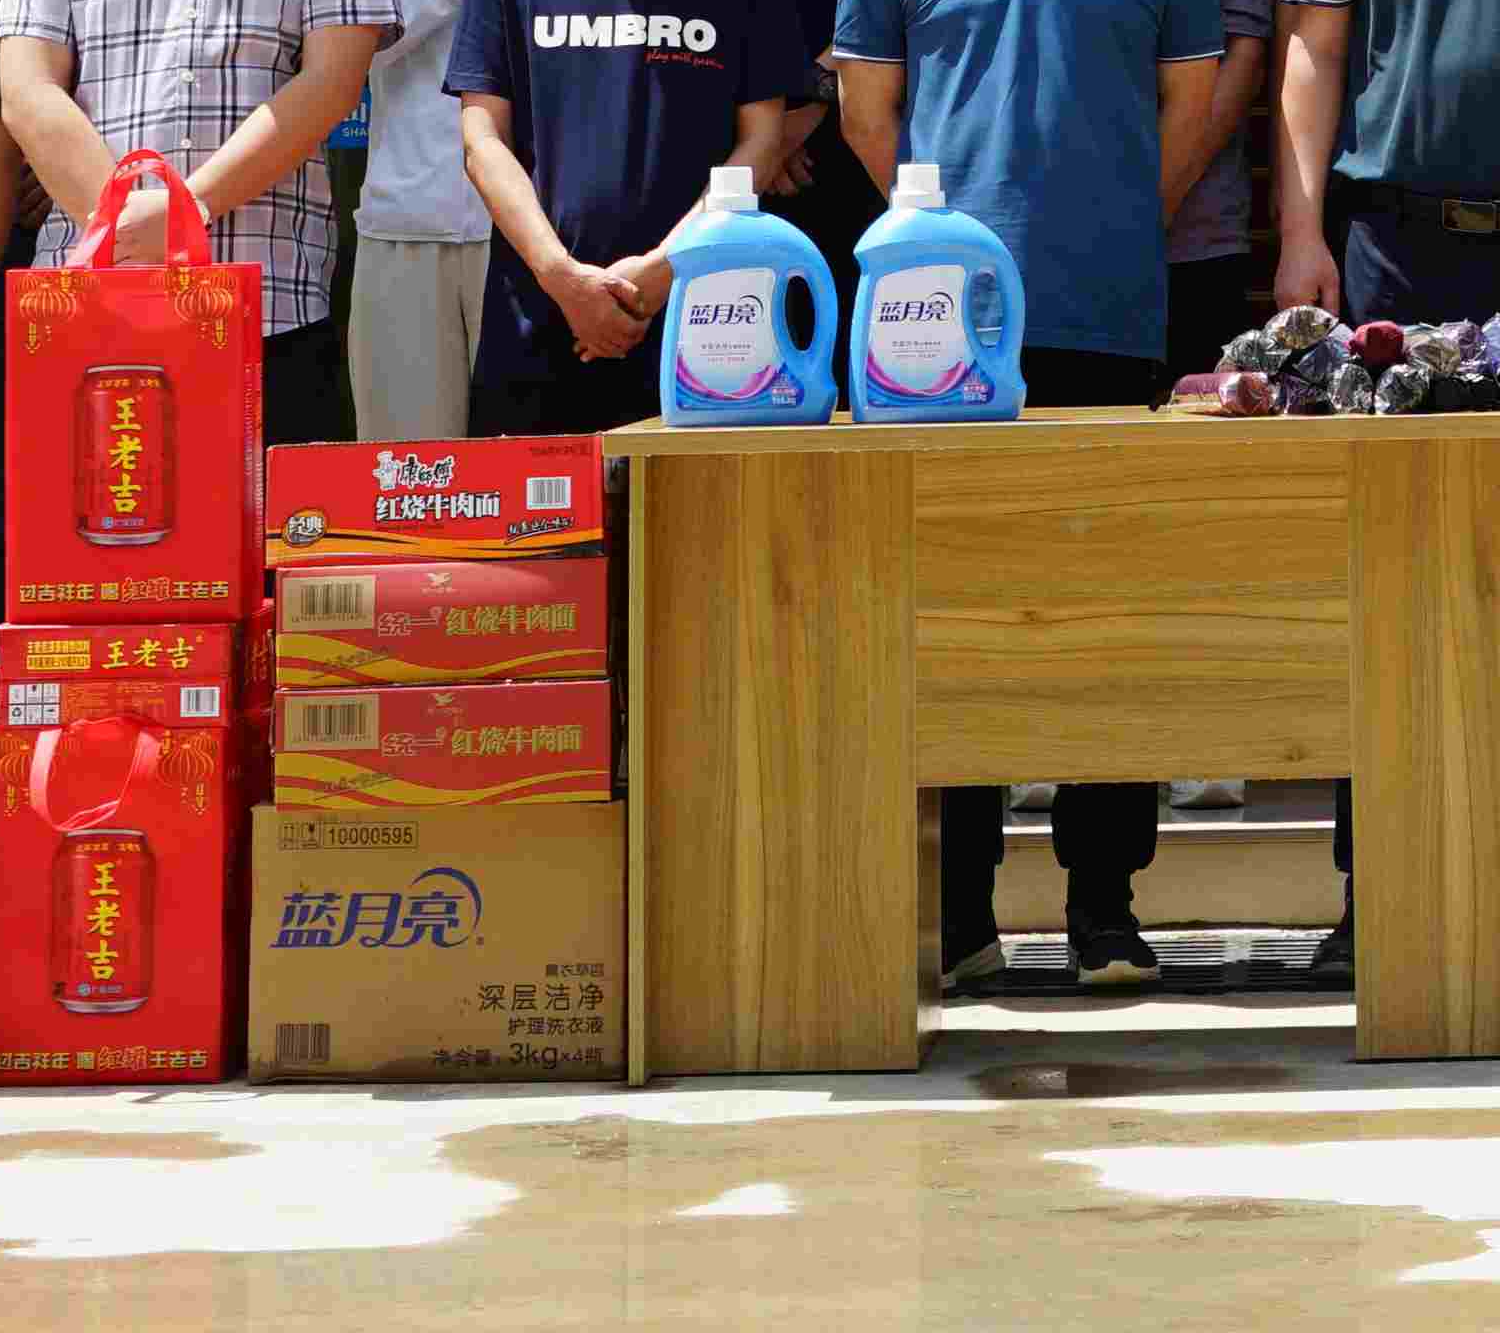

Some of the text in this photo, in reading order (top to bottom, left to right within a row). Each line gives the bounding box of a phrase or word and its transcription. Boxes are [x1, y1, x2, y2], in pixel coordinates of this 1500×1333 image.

[533, 14, 717, 53] UMBRO
[690, 302, 757, 325] 蓝月亮
[878, 300, 948, 323] 蓝月亮
[108, 397, 144, 514] 王老吉
[375, 492, 500, 521] 红烧牛肉面
[446, 603, 577, 635] 红烧牛肉面
[101, 637, 195, 669] 王老吉
[450, 725, 587, 756] 红烧牛肉面
[328, 825, 414, 846] 10000595
[86, 862, 122, 981] 王老吉
[270, 887, 468, 950] 蓝月亮
[477, 984, 605, 1013] 深层洁净
[507, 1017, 605, 1037] 护理洗衣液
